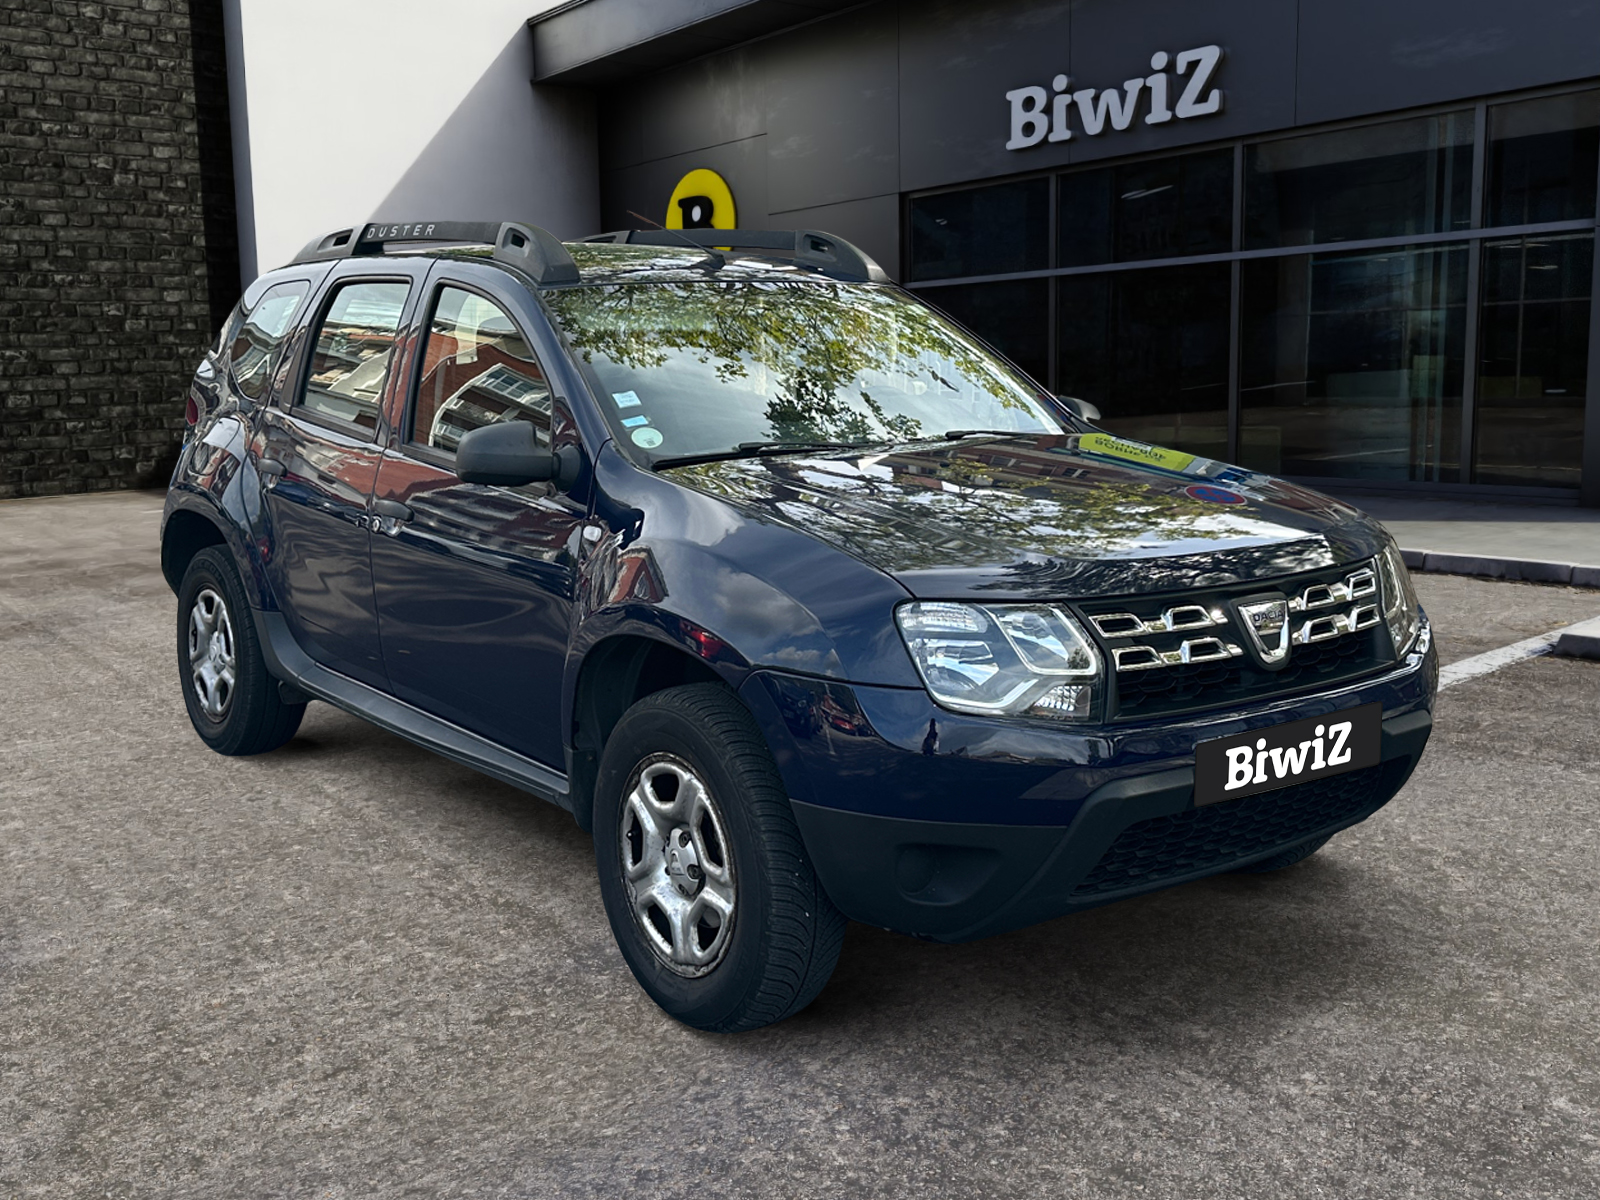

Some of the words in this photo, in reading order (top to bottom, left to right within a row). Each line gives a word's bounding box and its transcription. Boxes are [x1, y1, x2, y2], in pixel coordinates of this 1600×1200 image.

[1006, 45, 1221, 150] BiwiZ
[367, 224, 435, 238] DUSTER
[1253, 610, 1284, 622] DACIA
[1224, 721, 1352, 791] BiwiZ
